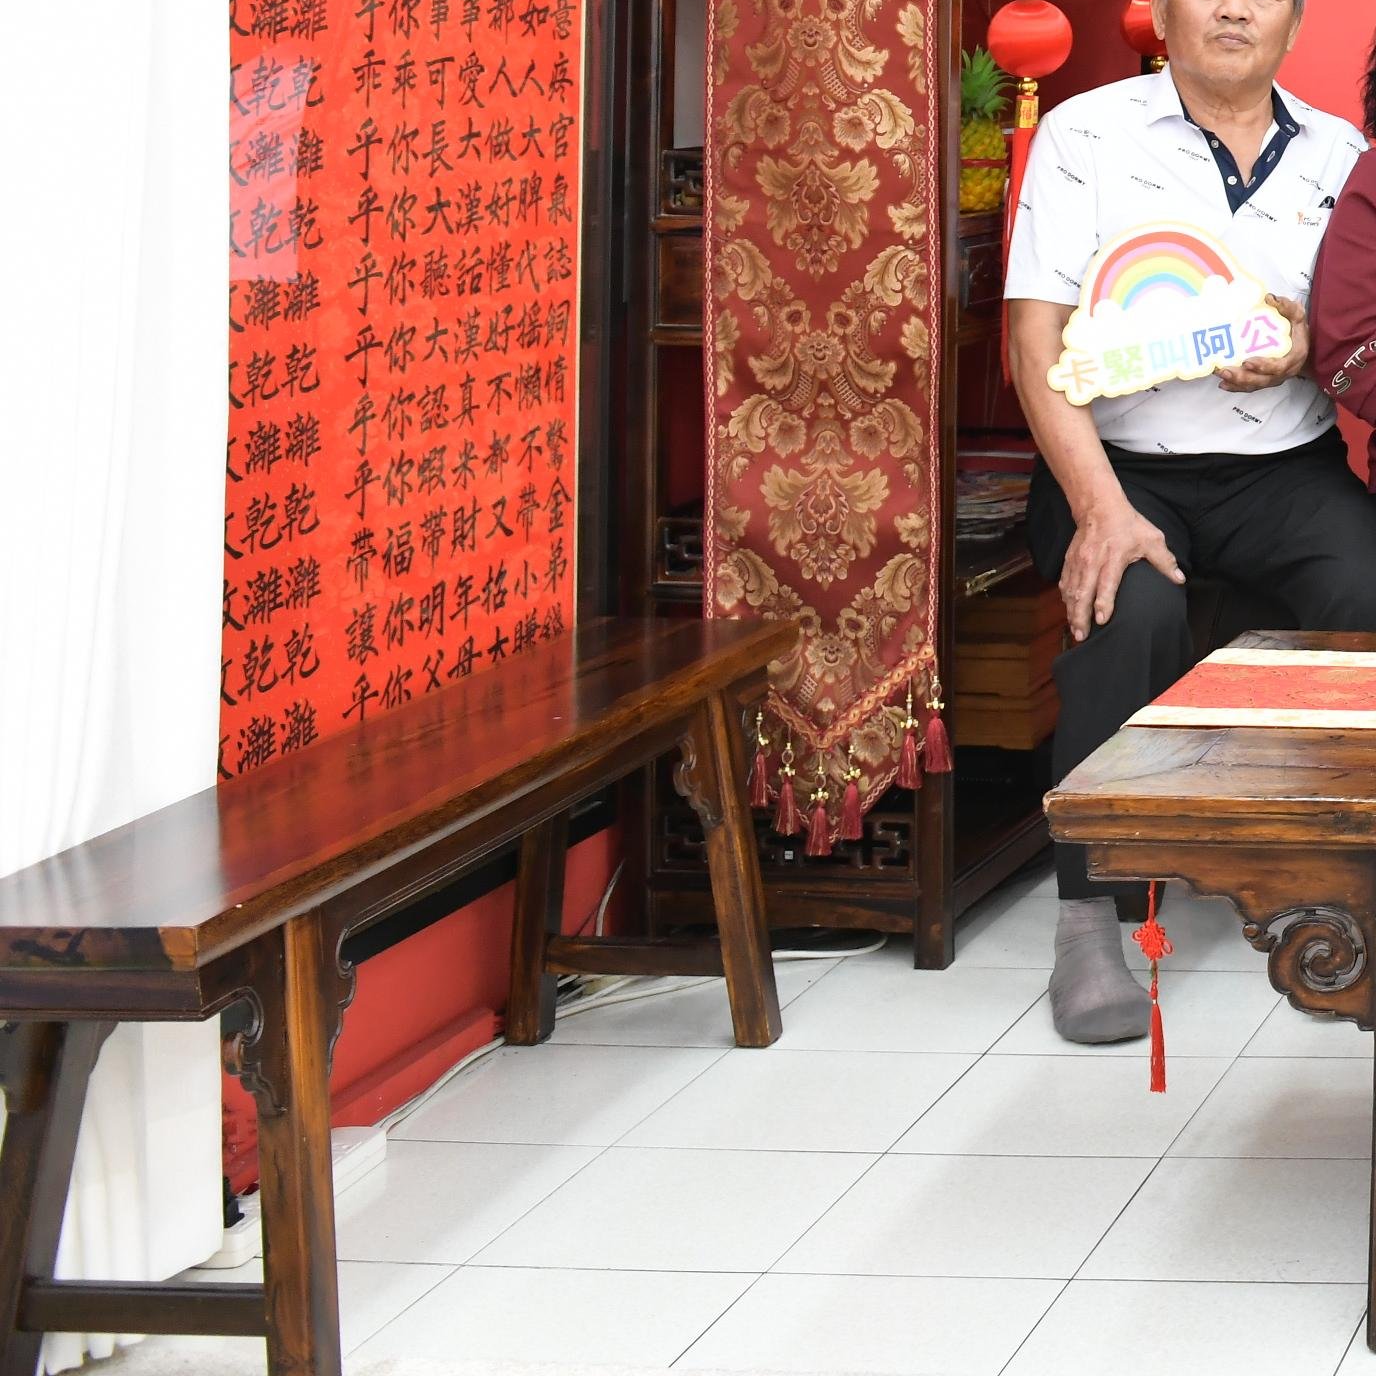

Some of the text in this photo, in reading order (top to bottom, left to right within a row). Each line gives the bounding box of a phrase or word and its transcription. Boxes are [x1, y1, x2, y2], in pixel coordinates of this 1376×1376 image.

[1178, 147, 1211, 163] PRO DORMY
[1057, 166, 1086, 186] PRO DORMY
[1131, 175, 1165, 190] PRO DORMY
[1246, 201, 1257, 210] PRO
[1257, 209, 1278, 223] DORMY
[1054, 269, 1065, 279] PRO
[1061, 315, 1279, 394] 卡緊叫阿公
[1232, 406, 1244, 416] PRO
[1243, 413, 1263, 425] DORMY
